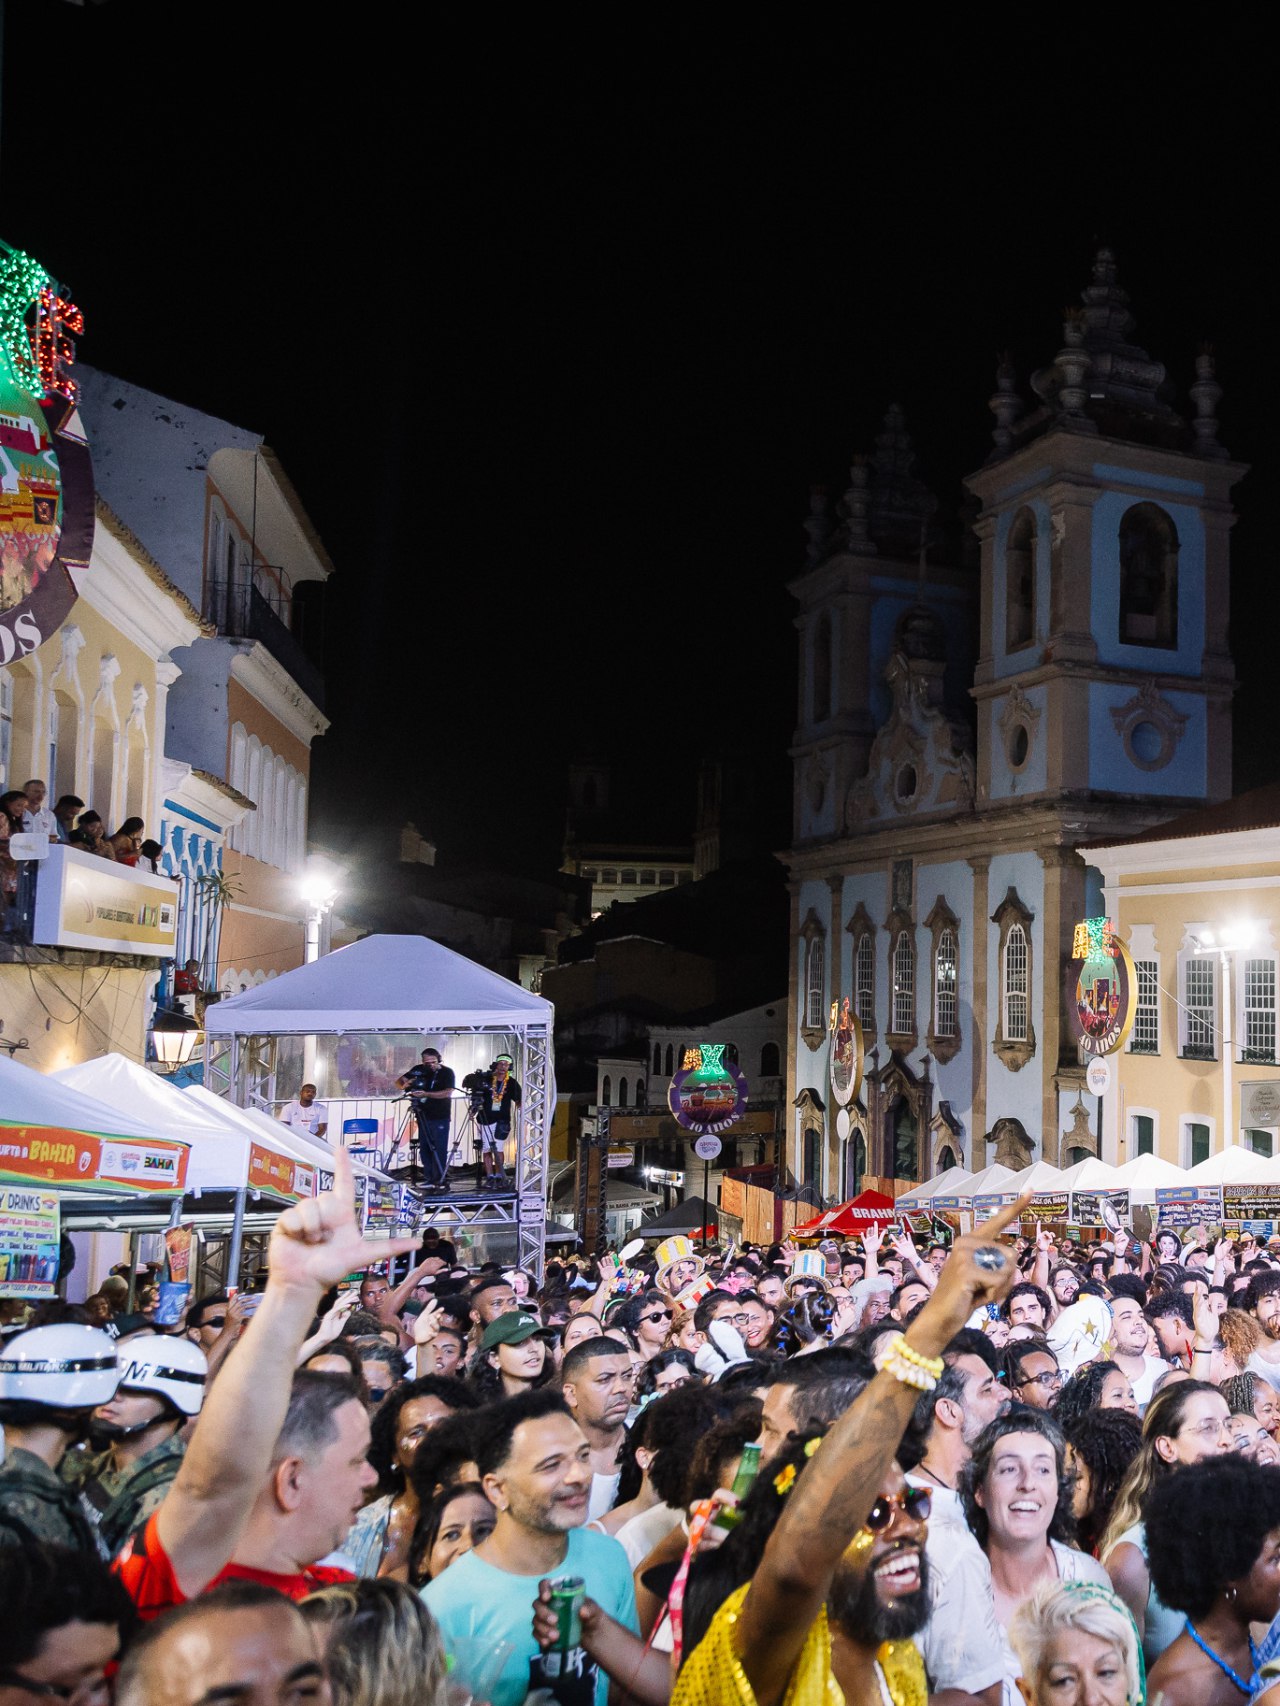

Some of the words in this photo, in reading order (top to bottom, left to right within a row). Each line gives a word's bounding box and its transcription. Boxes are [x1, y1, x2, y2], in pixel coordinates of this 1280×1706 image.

[1078, 1034, 1092, 1051] 40
[1094, 1021, 1121, 1054] ANOS
[29, 1140, 77, 1165] BAHIA
[8, 1193, 41, 1211] DRINKS
[851, 1208, 896, 1219] BRAHM
